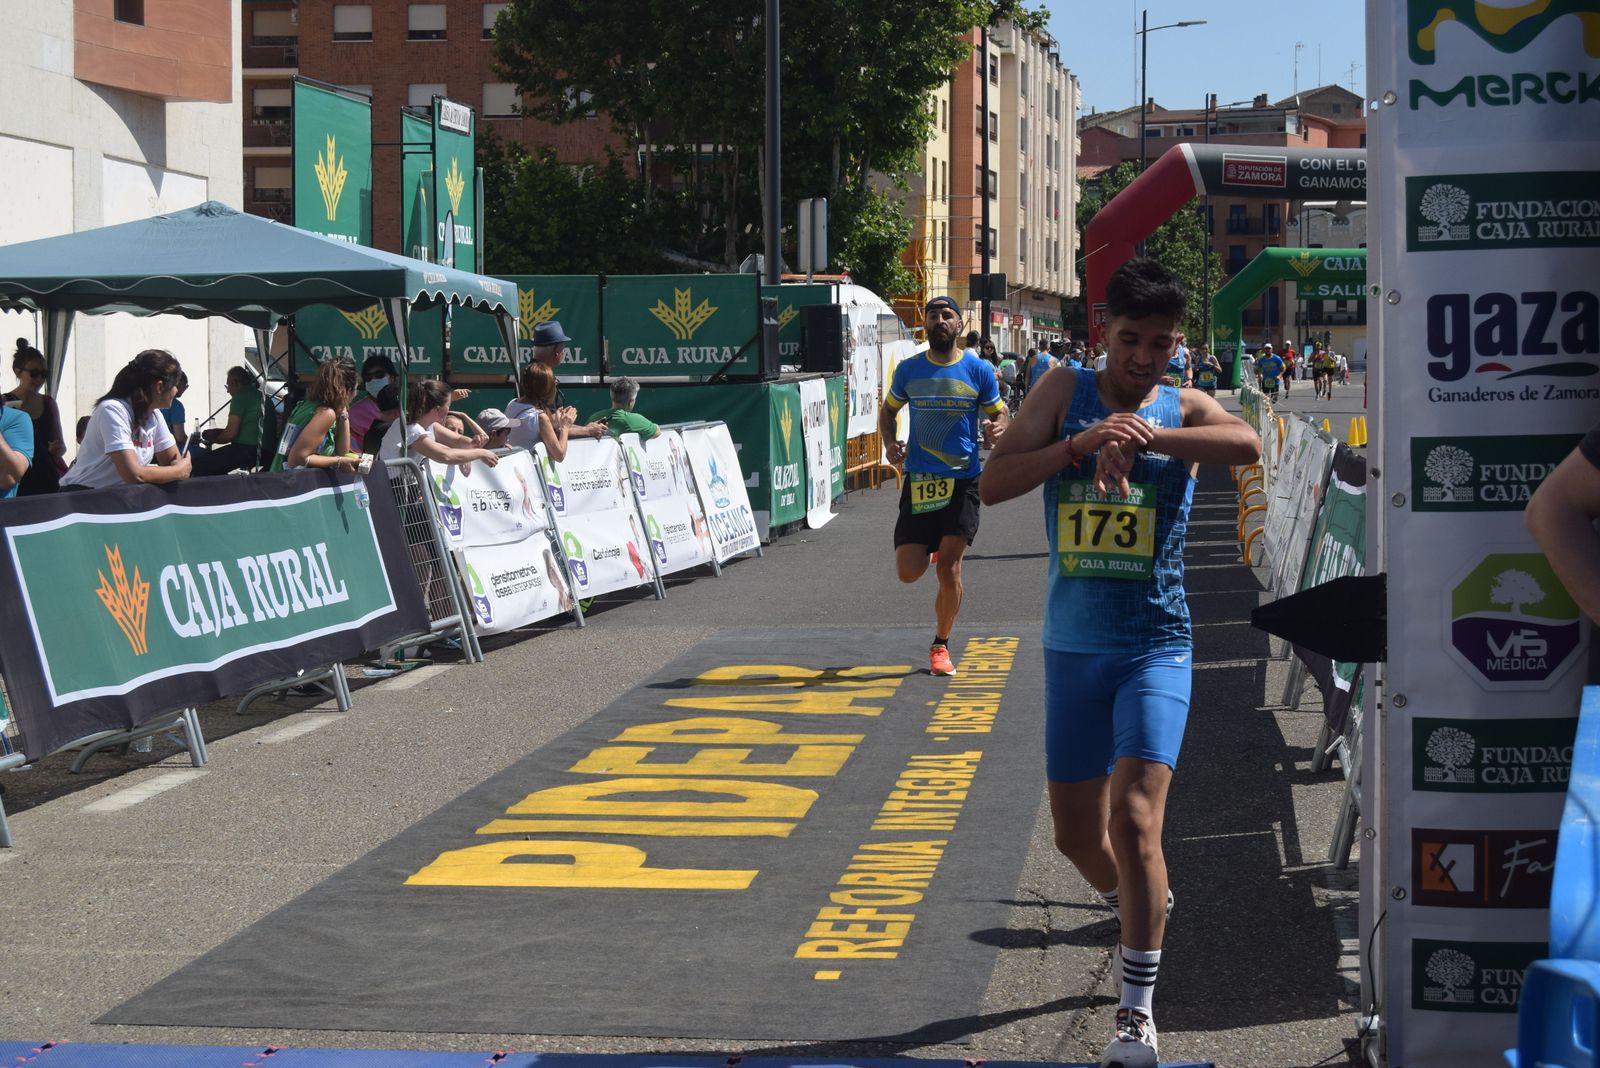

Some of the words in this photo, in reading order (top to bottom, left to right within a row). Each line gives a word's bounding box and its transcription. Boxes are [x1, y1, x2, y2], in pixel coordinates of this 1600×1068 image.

[1300, 158, 1331, 170] CON
[1336, 159, 1353, 171] EL
[1238, 171, 1282, 182] ZAMORA
[1476, 222, 1531, 241] CAJA
[1323, 256, 1363, 271] CAJA
[1427, 290, 1600, 382] gaza
[463, 346, 512, 363] CAJA
[621, 347, 672, 365] CAJA
[677, 345, 747, 363] RURAL
[1428, 386, 1515, 402] Ganaderos
[1525, 386, 1538, 401] de
[1544, 383, 1600, 401] Zamora
[916, 481, 948, 500] 193
[1480, 484, 1532, 502] CAJA
[709, 504, 754, 544] OCEANIC
[1068, 508, 1138, 549] 173
[1080, 559, 1106, 570] CAJA
[1108, 560, 1147, 573] RURAL
[160, 560, 249, 638] CAJA
[236, 542, 349, 622] RURAL
[403, 665, 912, 890] PIDEPAR
[1481, 766, 1536, 784] CAJA
[870, 750, 983, 831] INTEGRAL
[794, 839, 949, 959] REFORMA
